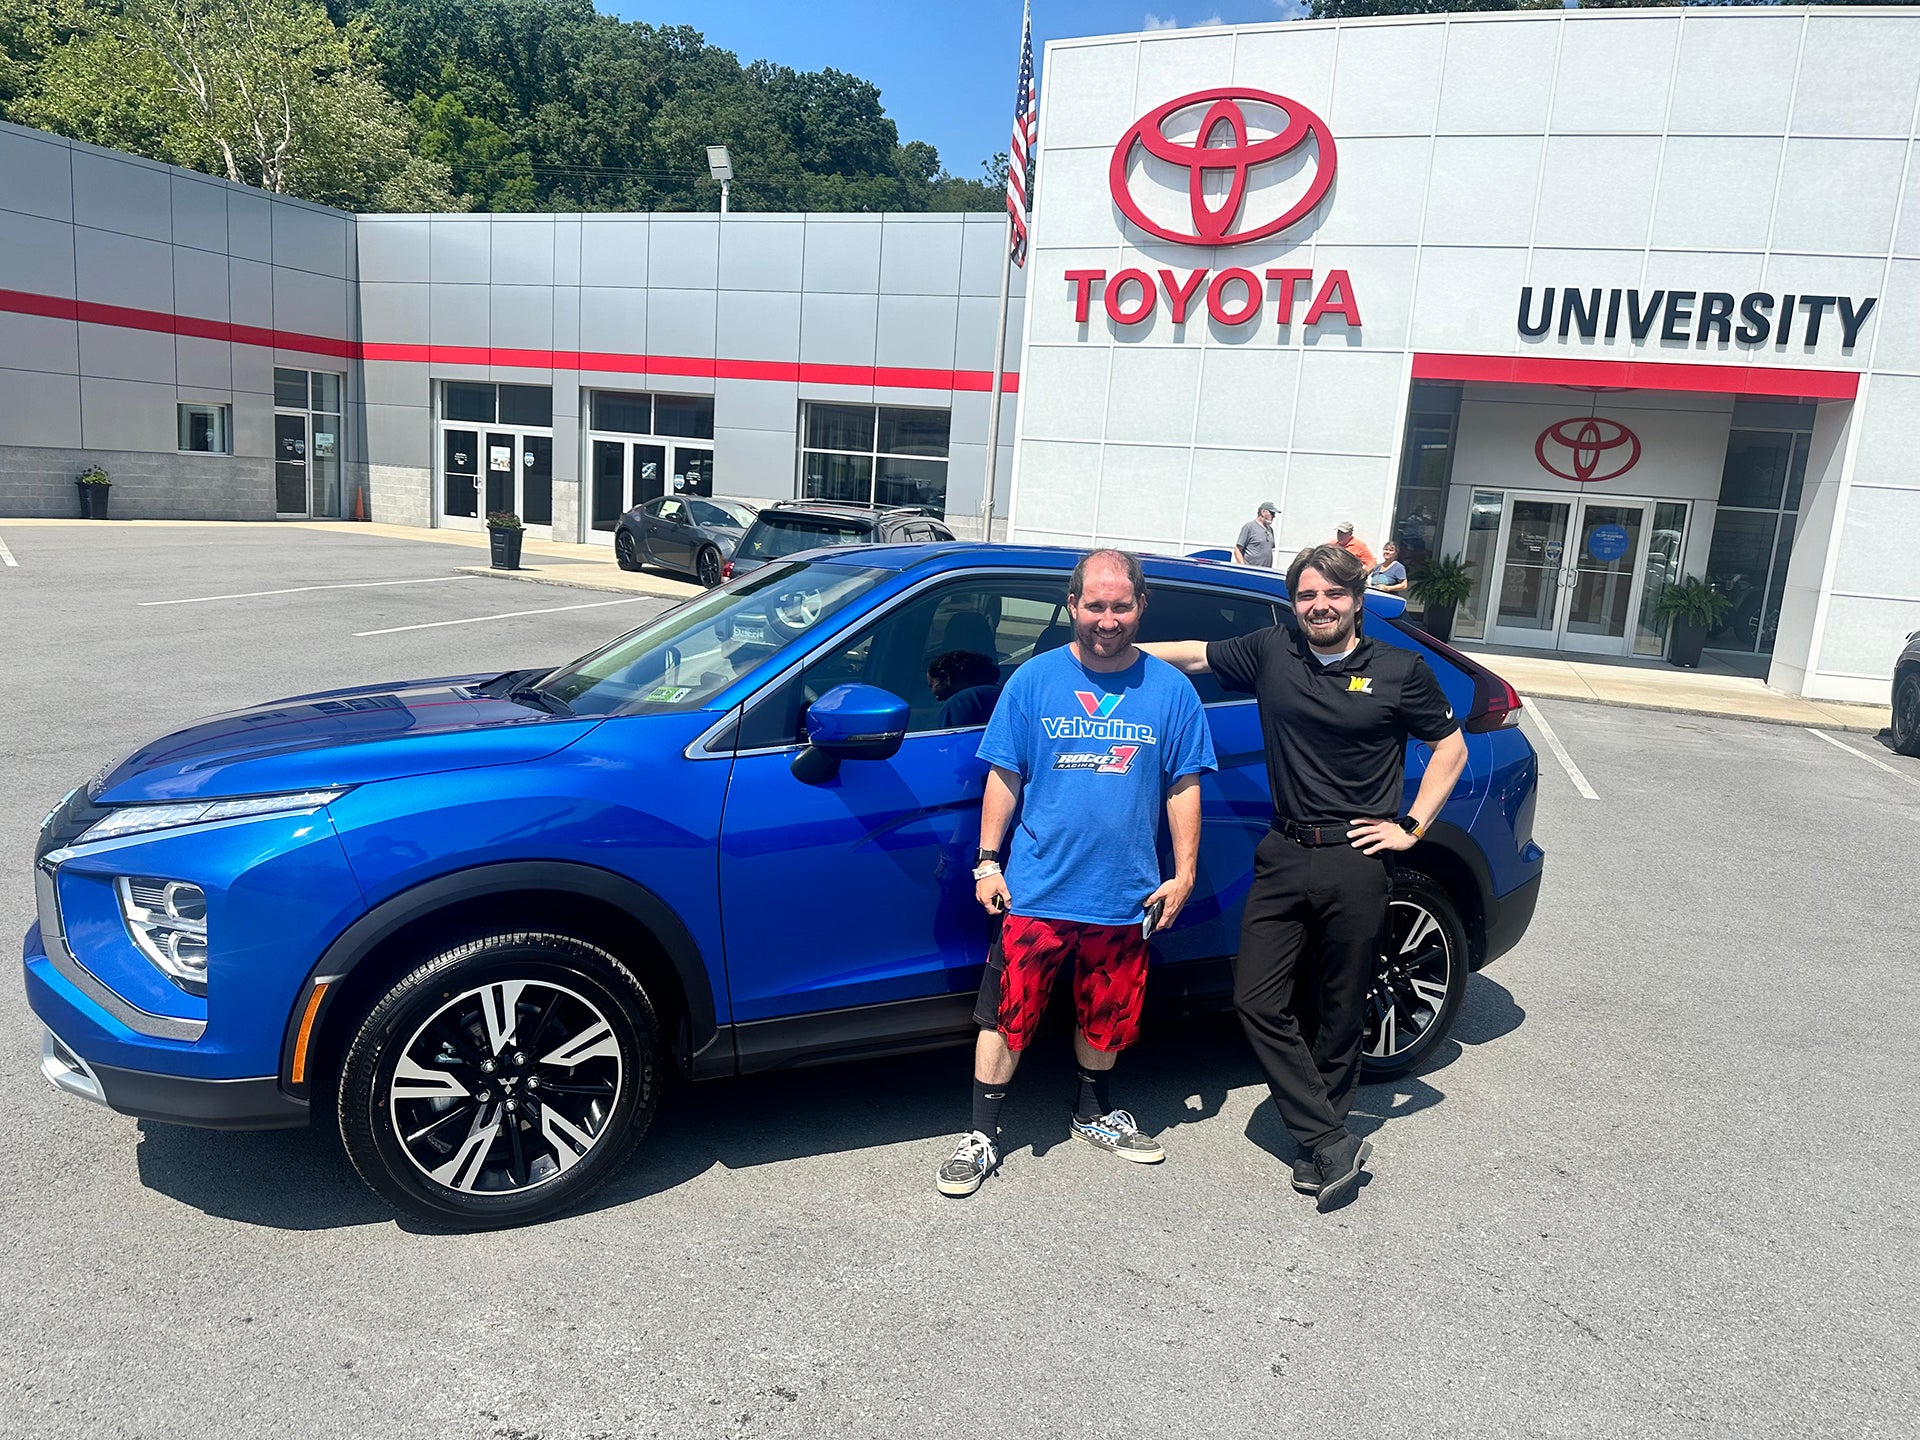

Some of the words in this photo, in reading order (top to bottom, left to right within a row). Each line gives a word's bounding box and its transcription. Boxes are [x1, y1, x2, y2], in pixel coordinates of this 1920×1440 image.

[1064, 267, 1362, 327] TOYOTA
[1517, 286, 1878, 348] UNIVERSITY
[1041, 716, 1153, 742] Valvoline
